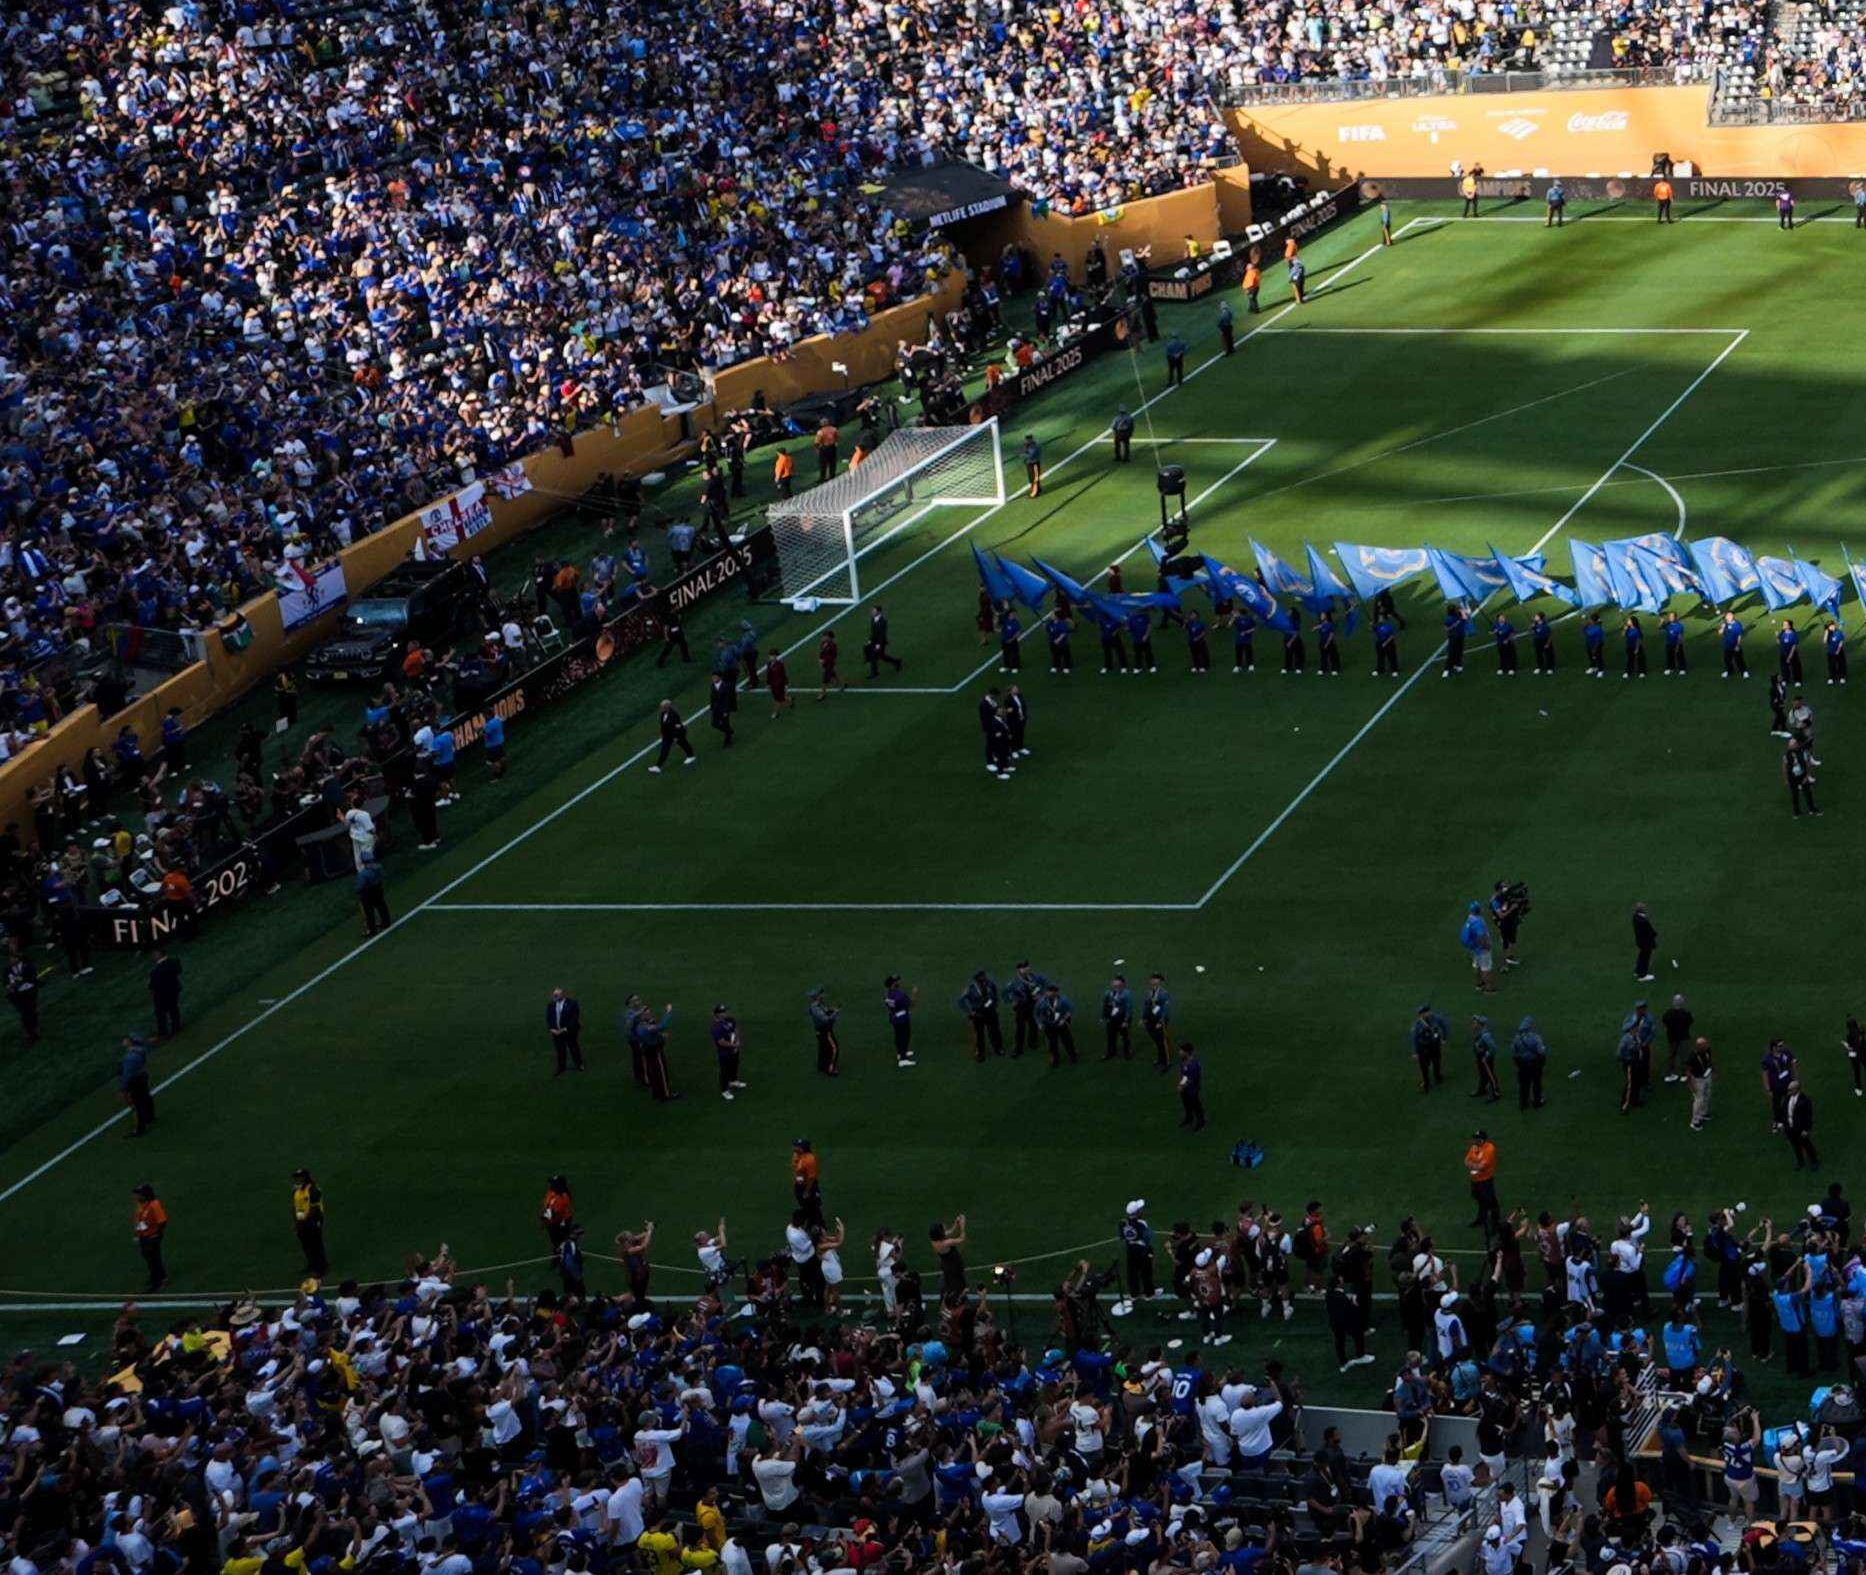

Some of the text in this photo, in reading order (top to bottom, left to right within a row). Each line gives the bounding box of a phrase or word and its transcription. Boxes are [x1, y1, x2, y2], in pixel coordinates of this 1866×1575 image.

[1337, 125, 1386, 143] FIFA
[1689, 181, 1786, 196] FINAL 2025
[1020, 362, 1054, 395] FINAL
[1172, 1379, 1192, 1400] 10
